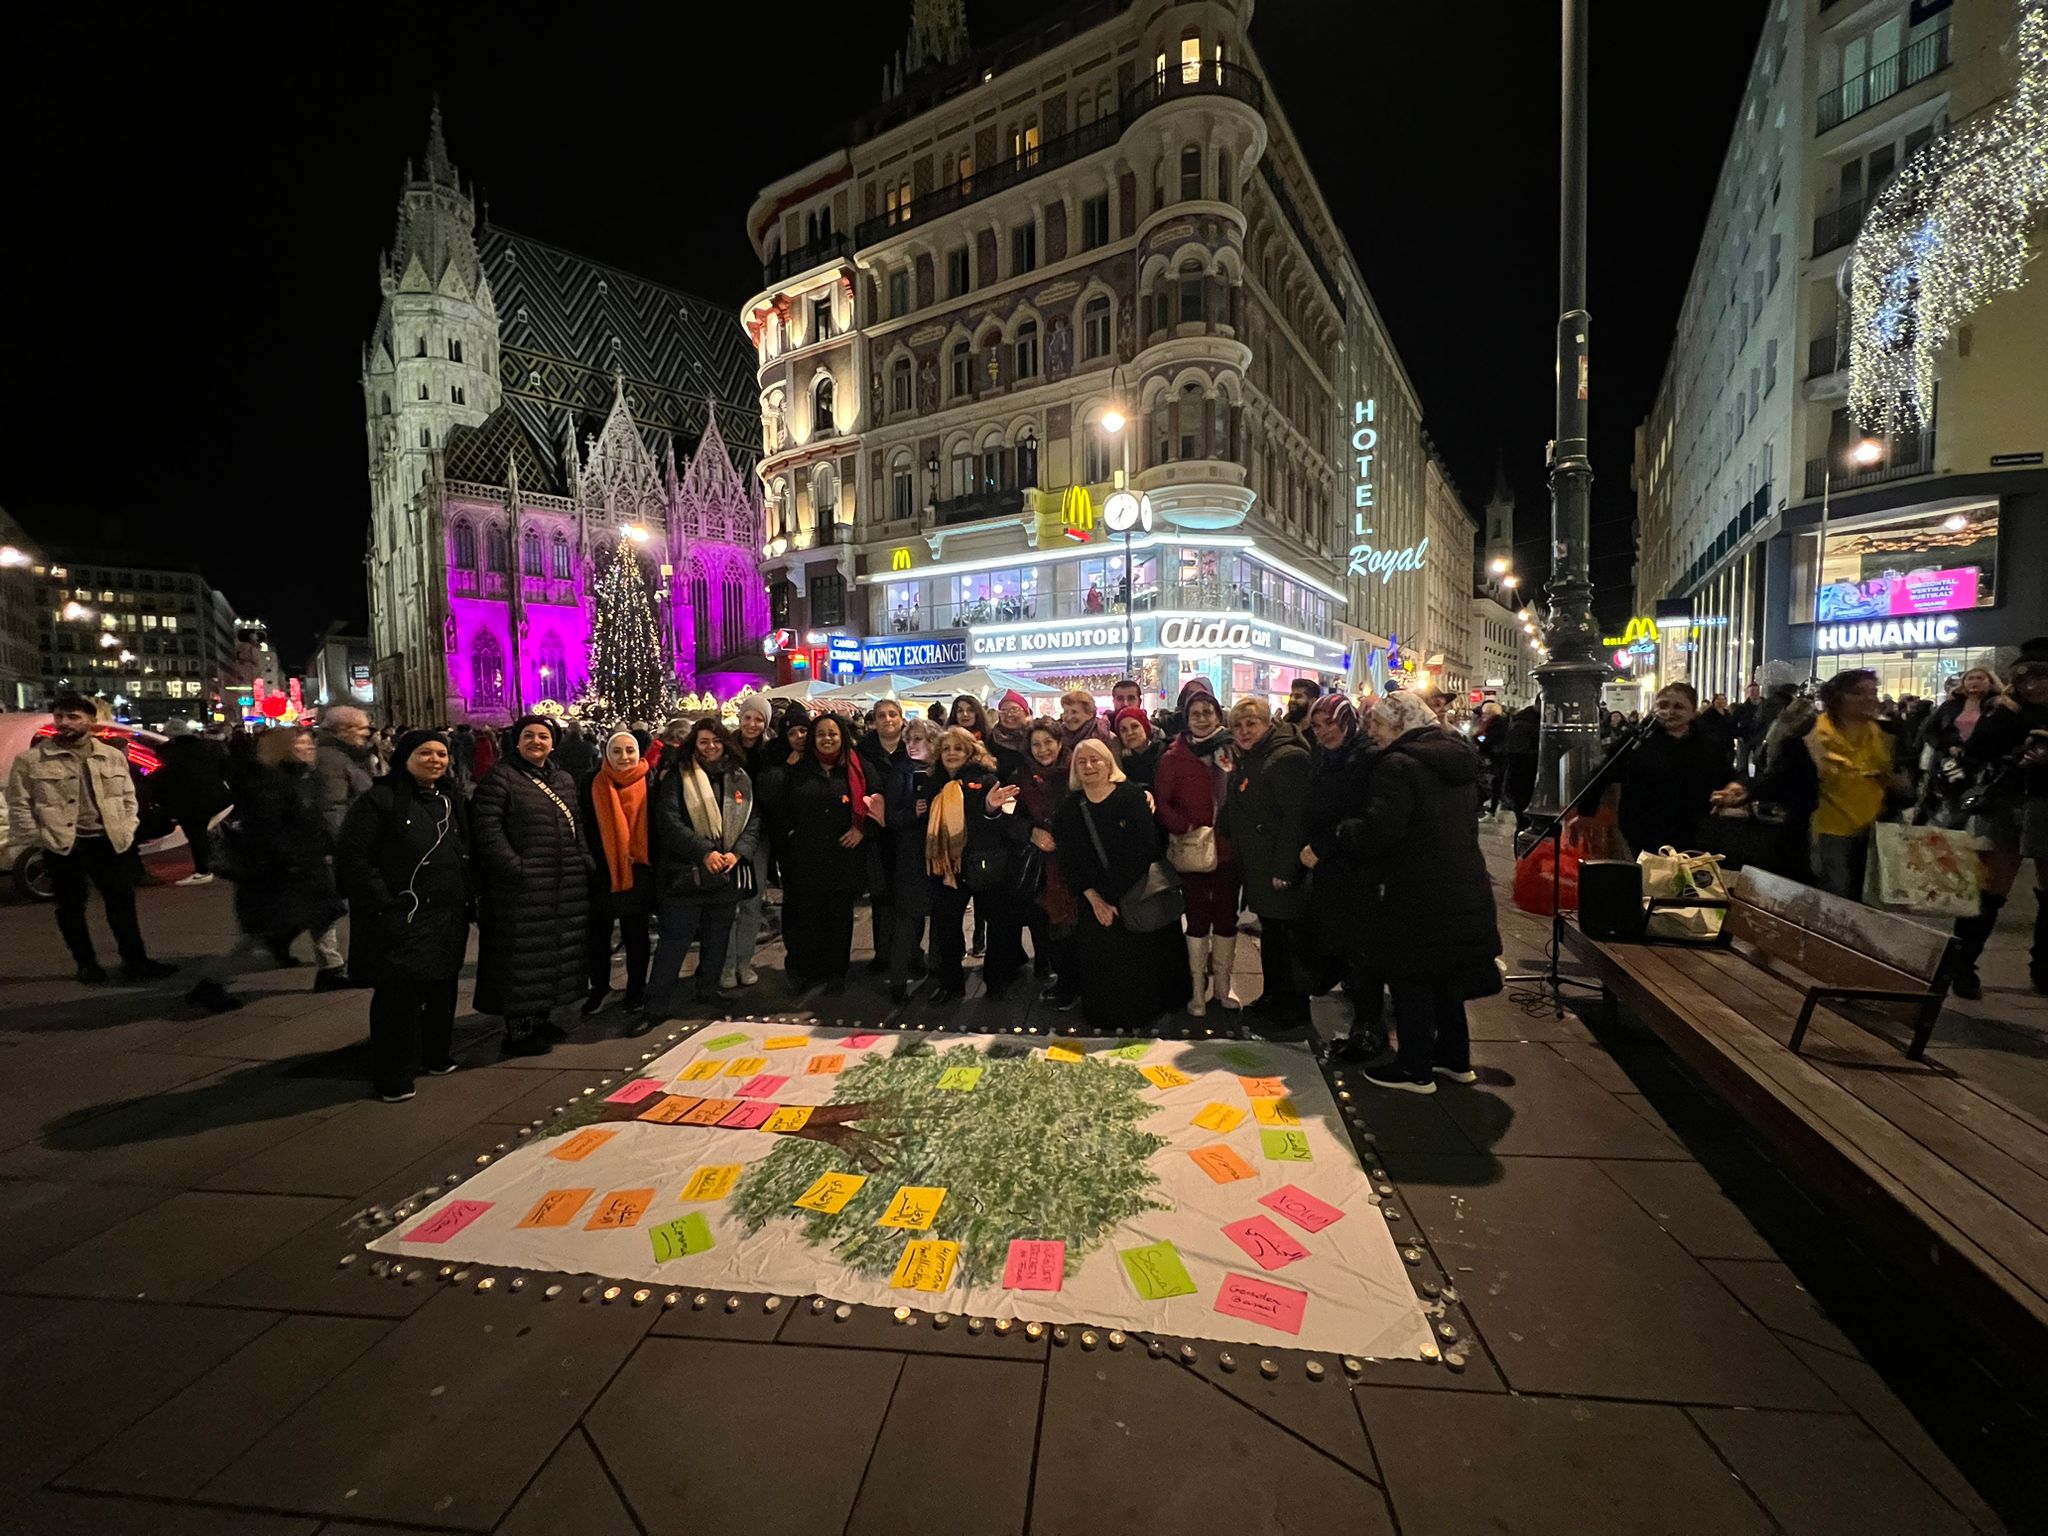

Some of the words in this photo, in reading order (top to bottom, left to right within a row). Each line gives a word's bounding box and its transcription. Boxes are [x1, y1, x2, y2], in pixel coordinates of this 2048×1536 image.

[1352, 399, 1377, 536] HOTEL
[1347, 536, 1429, 585] Royal
[1818, 618, 1959, 650] HUMANIC
[864, 647, 904, 668] MONEY
[904, 641, 966, 666] EXCHANGE
